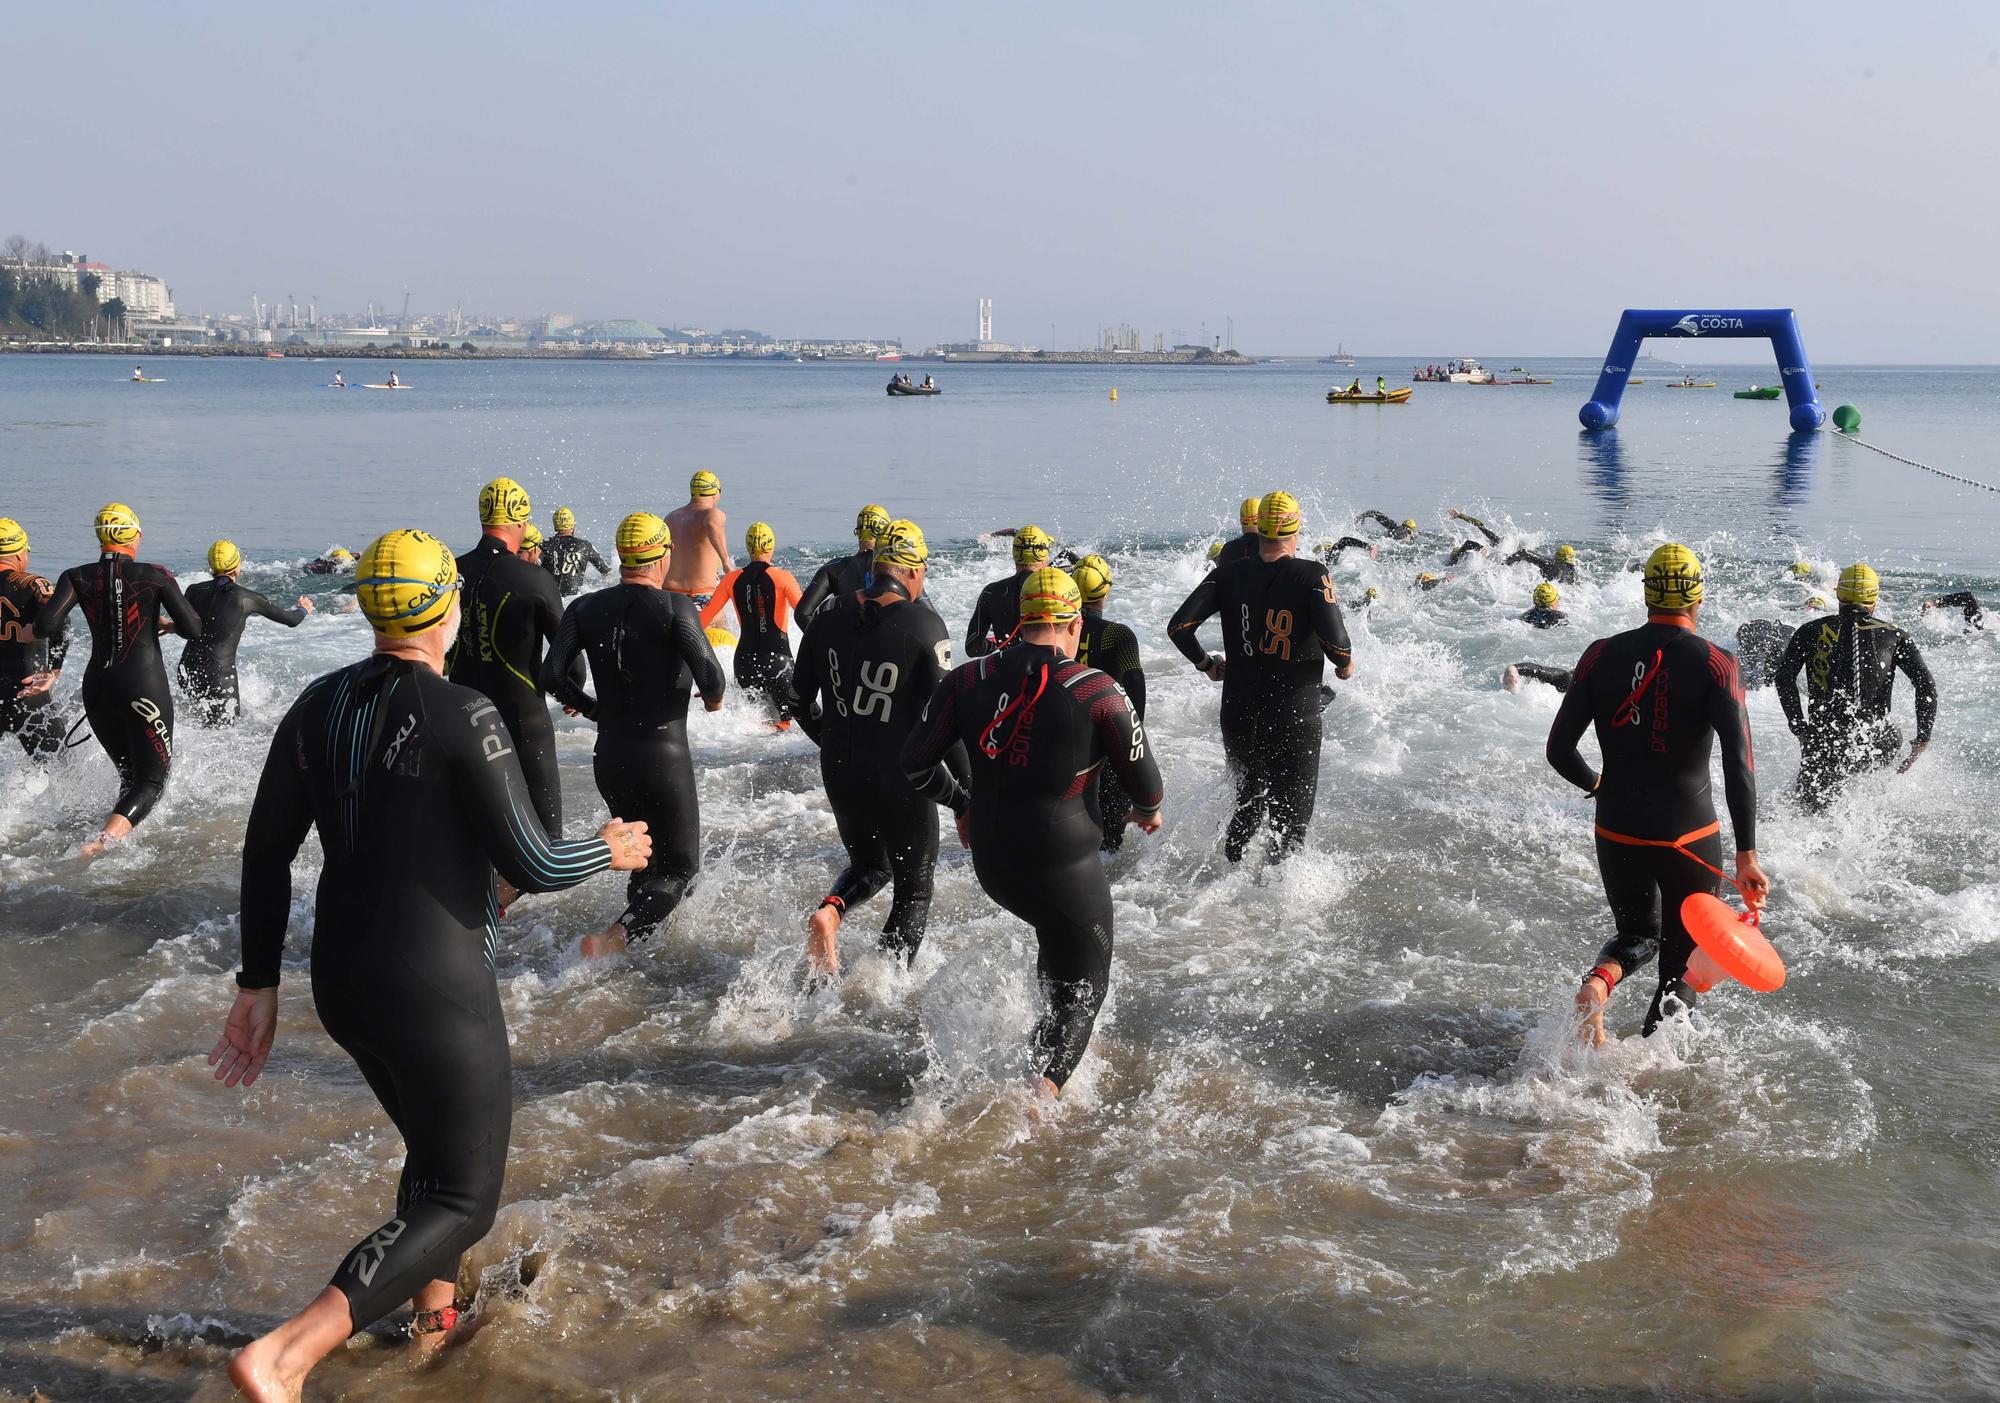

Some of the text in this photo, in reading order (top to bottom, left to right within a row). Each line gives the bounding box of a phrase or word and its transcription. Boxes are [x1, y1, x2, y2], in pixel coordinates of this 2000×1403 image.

[1700, 318, 1743, 328] COSTA
[115, 578, 123, 649] aquaman
[1241, 603, 1254, 656] orca
[828, 647, 848, 718] orca
[382, 713, 417, 770] 2XU
[347, 1218, 407, 1288] 2XU
